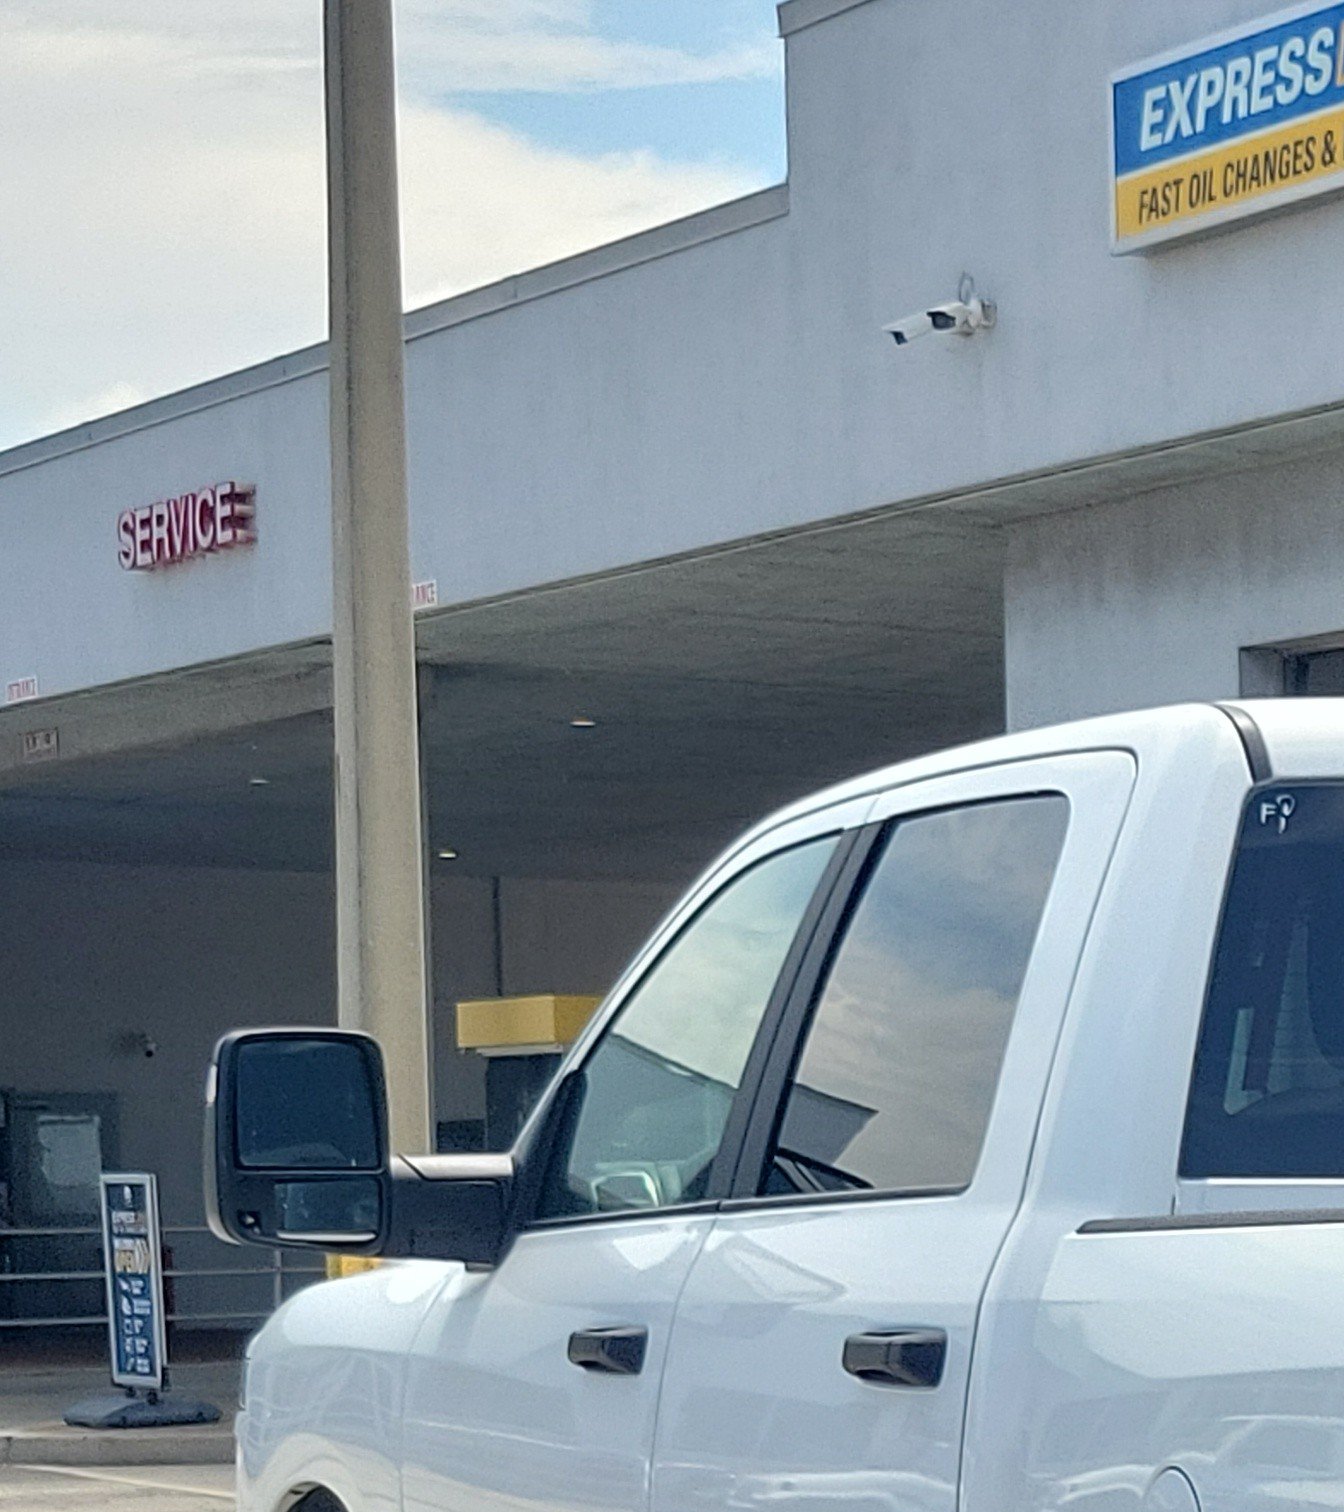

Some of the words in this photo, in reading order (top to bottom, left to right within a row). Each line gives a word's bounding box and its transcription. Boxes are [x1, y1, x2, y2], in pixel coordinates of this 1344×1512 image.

[1139, 178, 1183, 224] FAST
[1188, 170, 1217, 210] OIL
[1223, 137, 1314, 199] CHANGES
[1321, 135, 1337, 168] &
[117, 481, 257, 571] SERVICE
